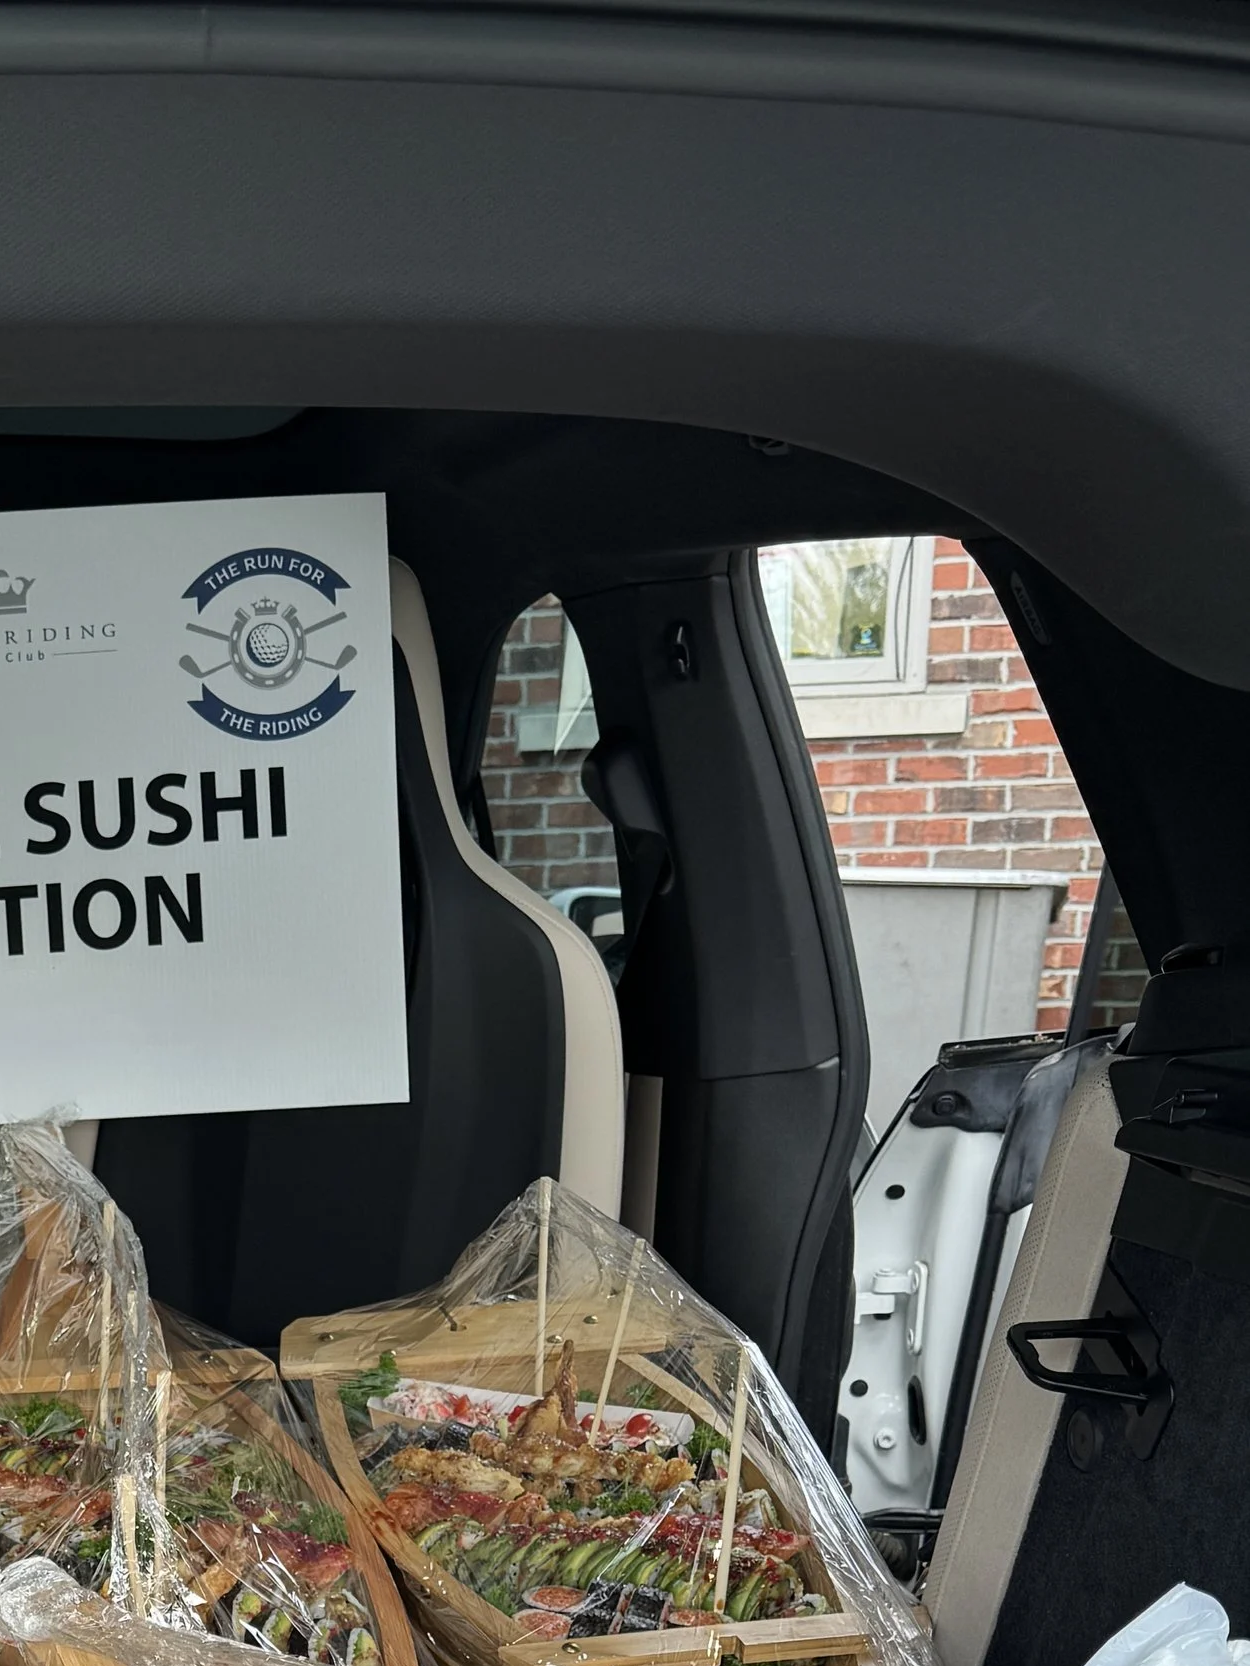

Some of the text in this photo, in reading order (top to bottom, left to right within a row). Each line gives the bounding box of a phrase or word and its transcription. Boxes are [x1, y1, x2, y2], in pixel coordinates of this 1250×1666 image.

[204, 554, 326, 590] THE RUN FOR
[4, 623, 117, 645] RIDING
[5, 650, 45, 663] Club
[219, 707, 323, 736] THE RIDING
[22, 766, 288, 856] SUSHI
